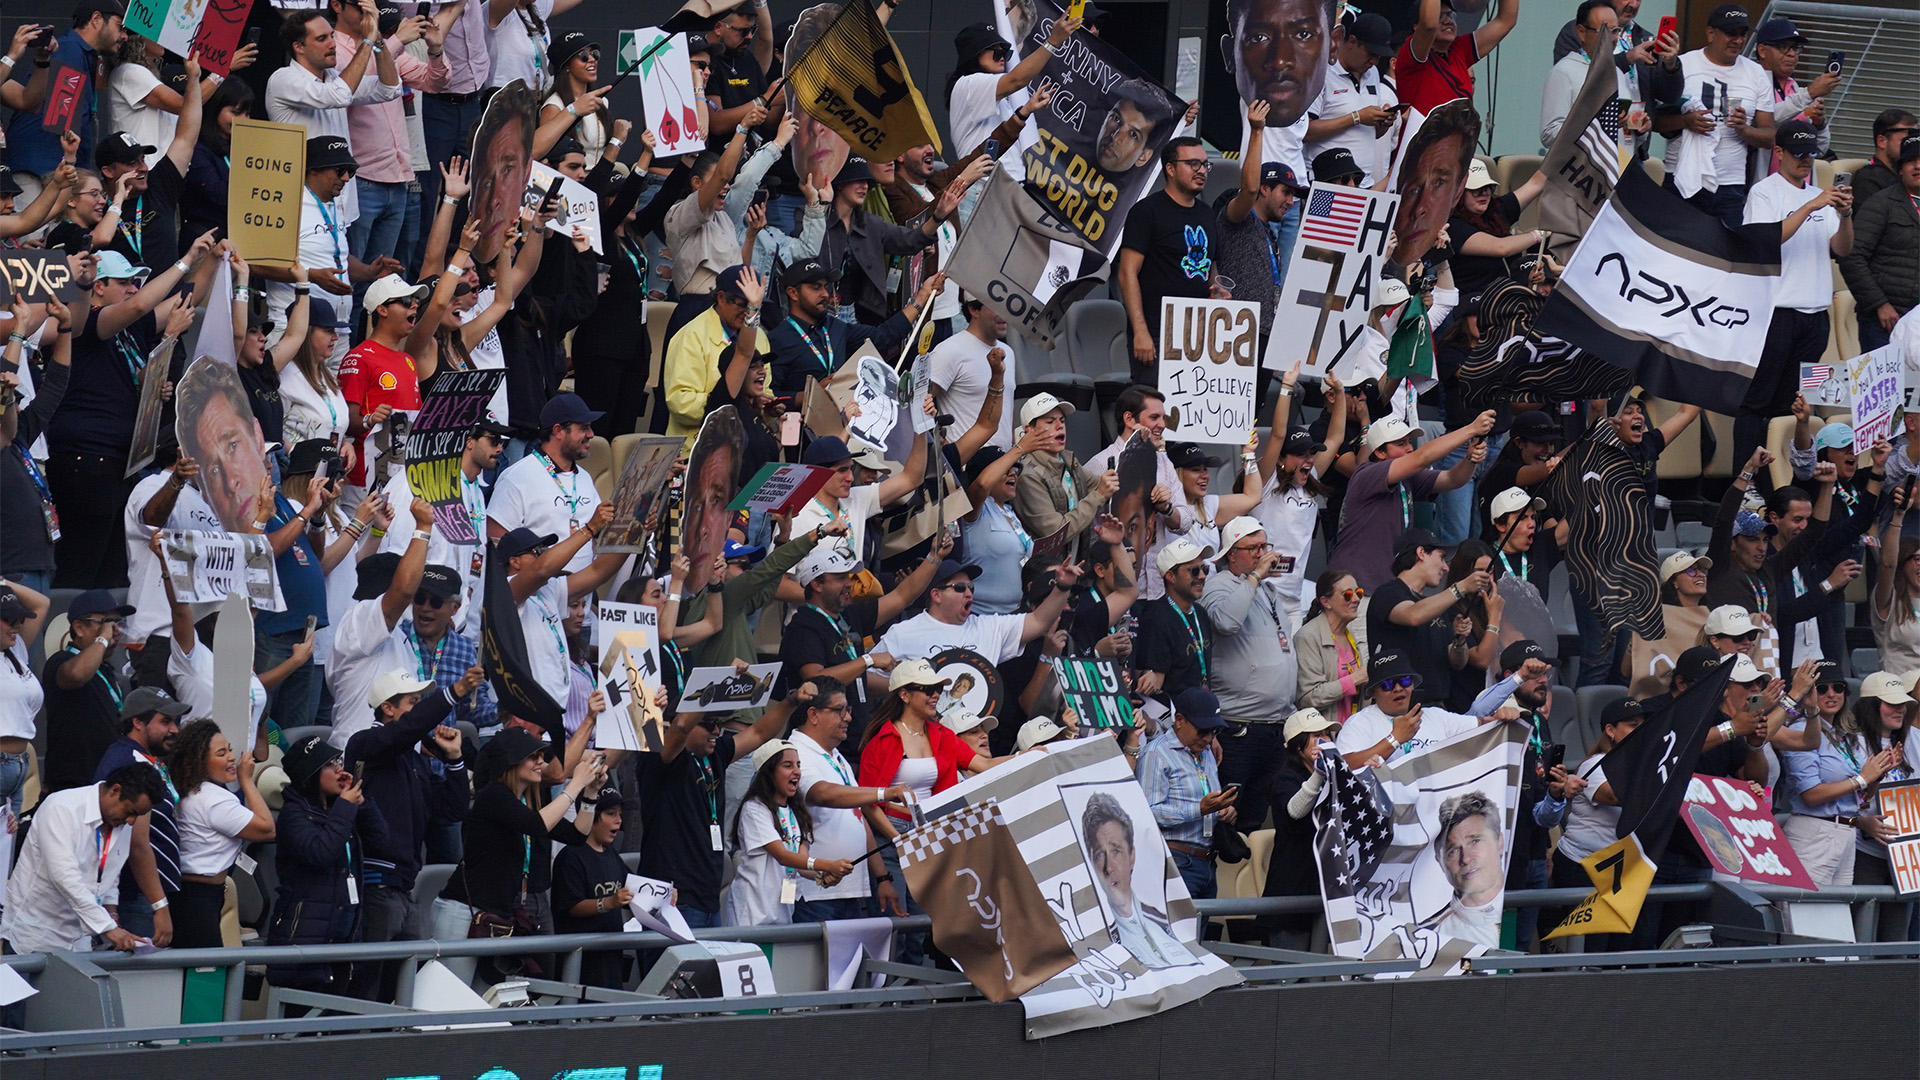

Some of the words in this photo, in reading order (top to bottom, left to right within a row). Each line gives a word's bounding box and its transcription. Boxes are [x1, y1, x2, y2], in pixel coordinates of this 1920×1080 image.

[814, 85, 887, 151] PEARCE
[245, 156, 293, 174] GOING
[1038, 127, 1069, 167] ST
[1065, 155, 1119, 212] DUO
[1559, 155, 1606, 206] HAY
[251, 187, 283, 203] FOR
[1026, 153, 1106, 241] WORLD
[244, 212, 285, 229] GOLD
[1595, 252, 1750, 329] APXGP
[1169, 369, 1188, 396] I
[1857, 376, 1897, 423] FASTER
[413, 394, 491, 430] HAYES
[407, 457, 462, 503] SONNY
[433, 503, 477, 542] AYES
[205, 545, 235, 571] WITH
[600, 607, 627, 623] FAST
[633, 611, 656, 626] LIKE
[1094, 695, 1135, 728] AMO
[1880, 785, 1920, 834] SON
[1594, 848, 1625, 895] 7
[1559, 907, 1593, 928] AYES
[738, 964, 757, 996] 8
